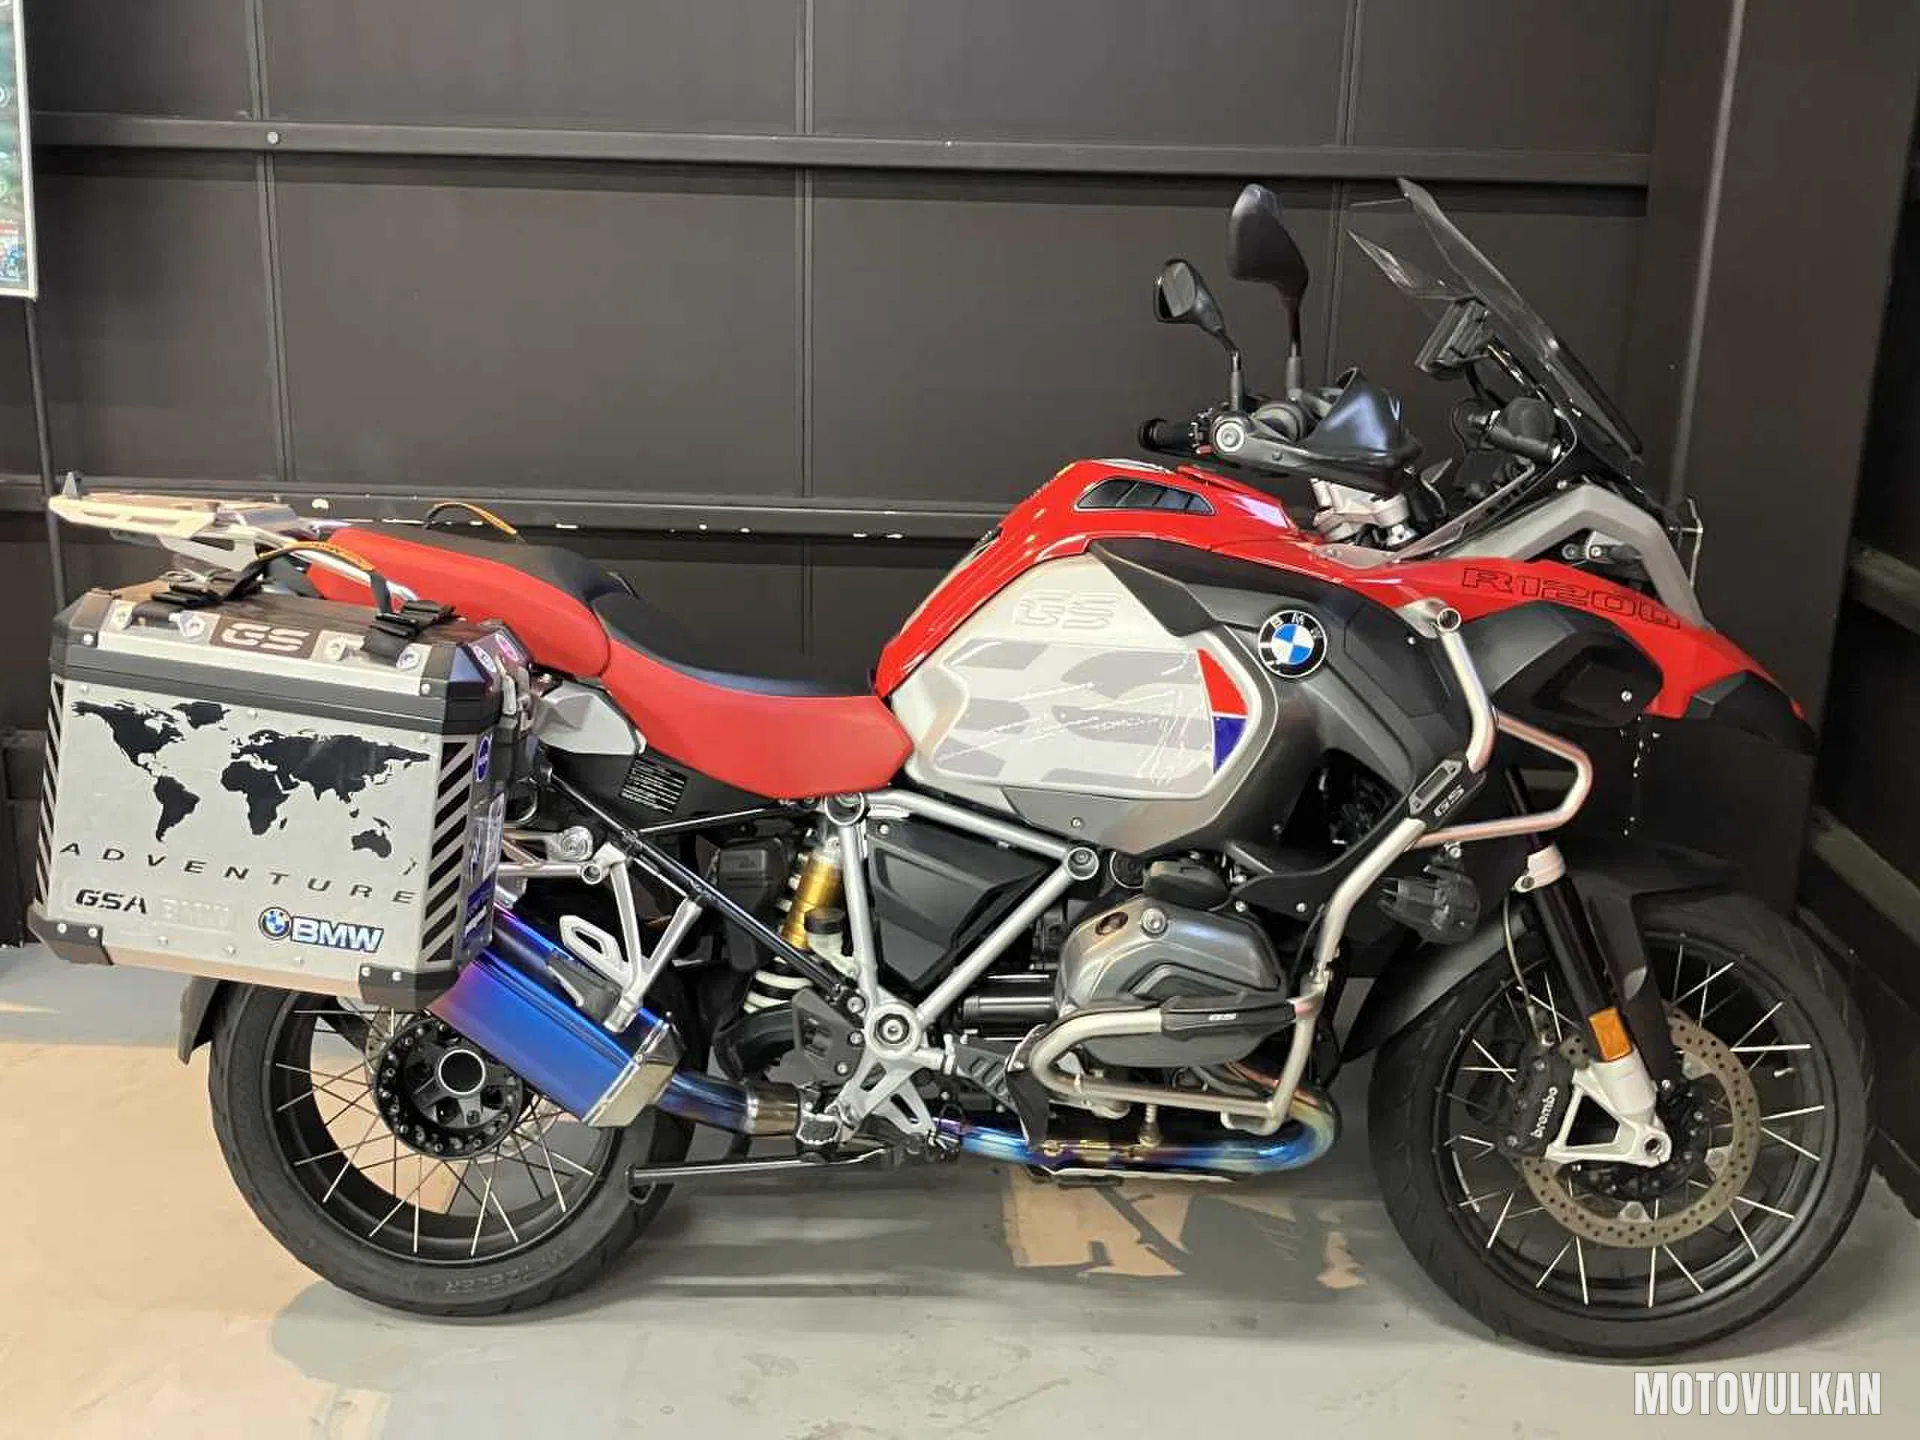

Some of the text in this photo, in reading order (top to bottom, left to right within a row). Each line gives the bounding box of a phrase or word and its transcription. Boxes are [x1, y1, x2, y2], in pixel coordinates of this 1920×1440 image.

[1013, 589, 1123, 630] GS
[221, 622, 311, 652] GS
[1433, 784, 1464, 817] GS
[59, 842, 416, 904] ADVENTURE
[75, 888, 147, 914] GSA
[291, 916, 384, 954] BMW
[1529, 1086, 1559, 1139] brembo
